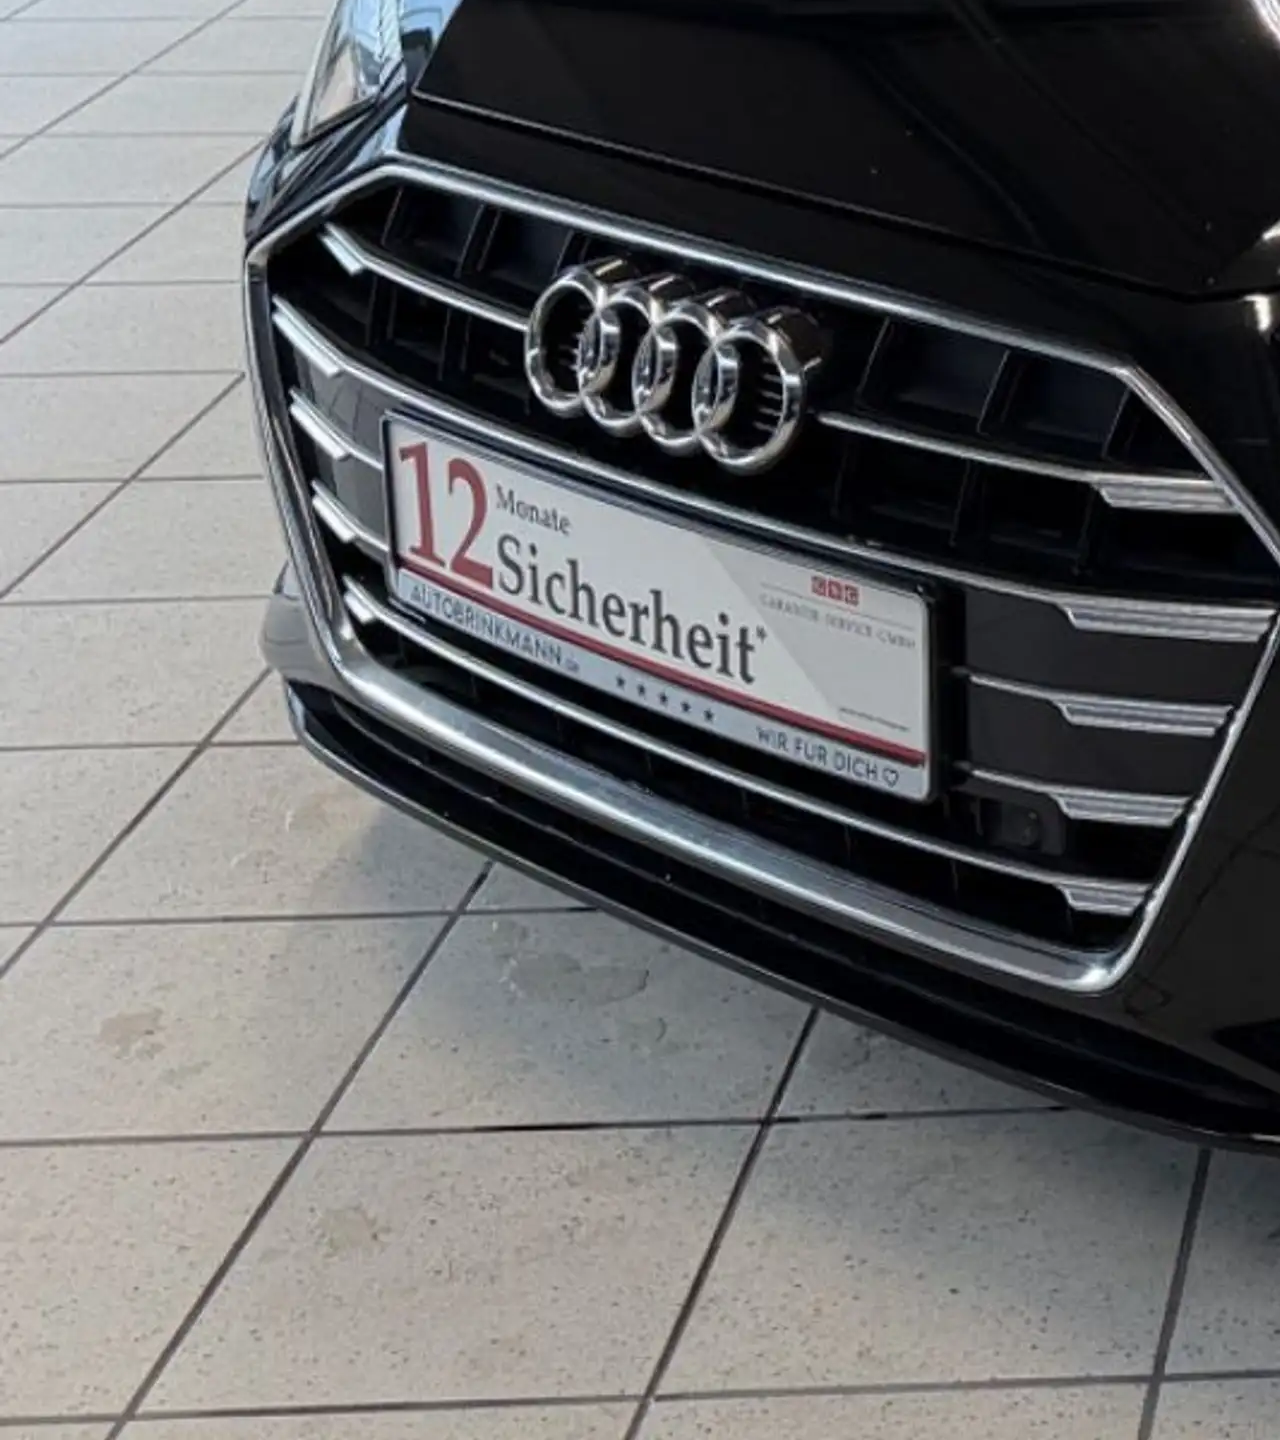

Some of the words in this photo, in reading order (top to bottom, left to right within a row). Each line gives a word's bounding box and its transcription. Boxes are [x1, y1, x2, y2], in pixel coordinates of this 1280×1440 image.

[399, 441, 493, 588] 12
[497, 484, 571, 536] Monate
[757, 726, 788, 751] WIR
[834, 750, 878, 780] DICH
